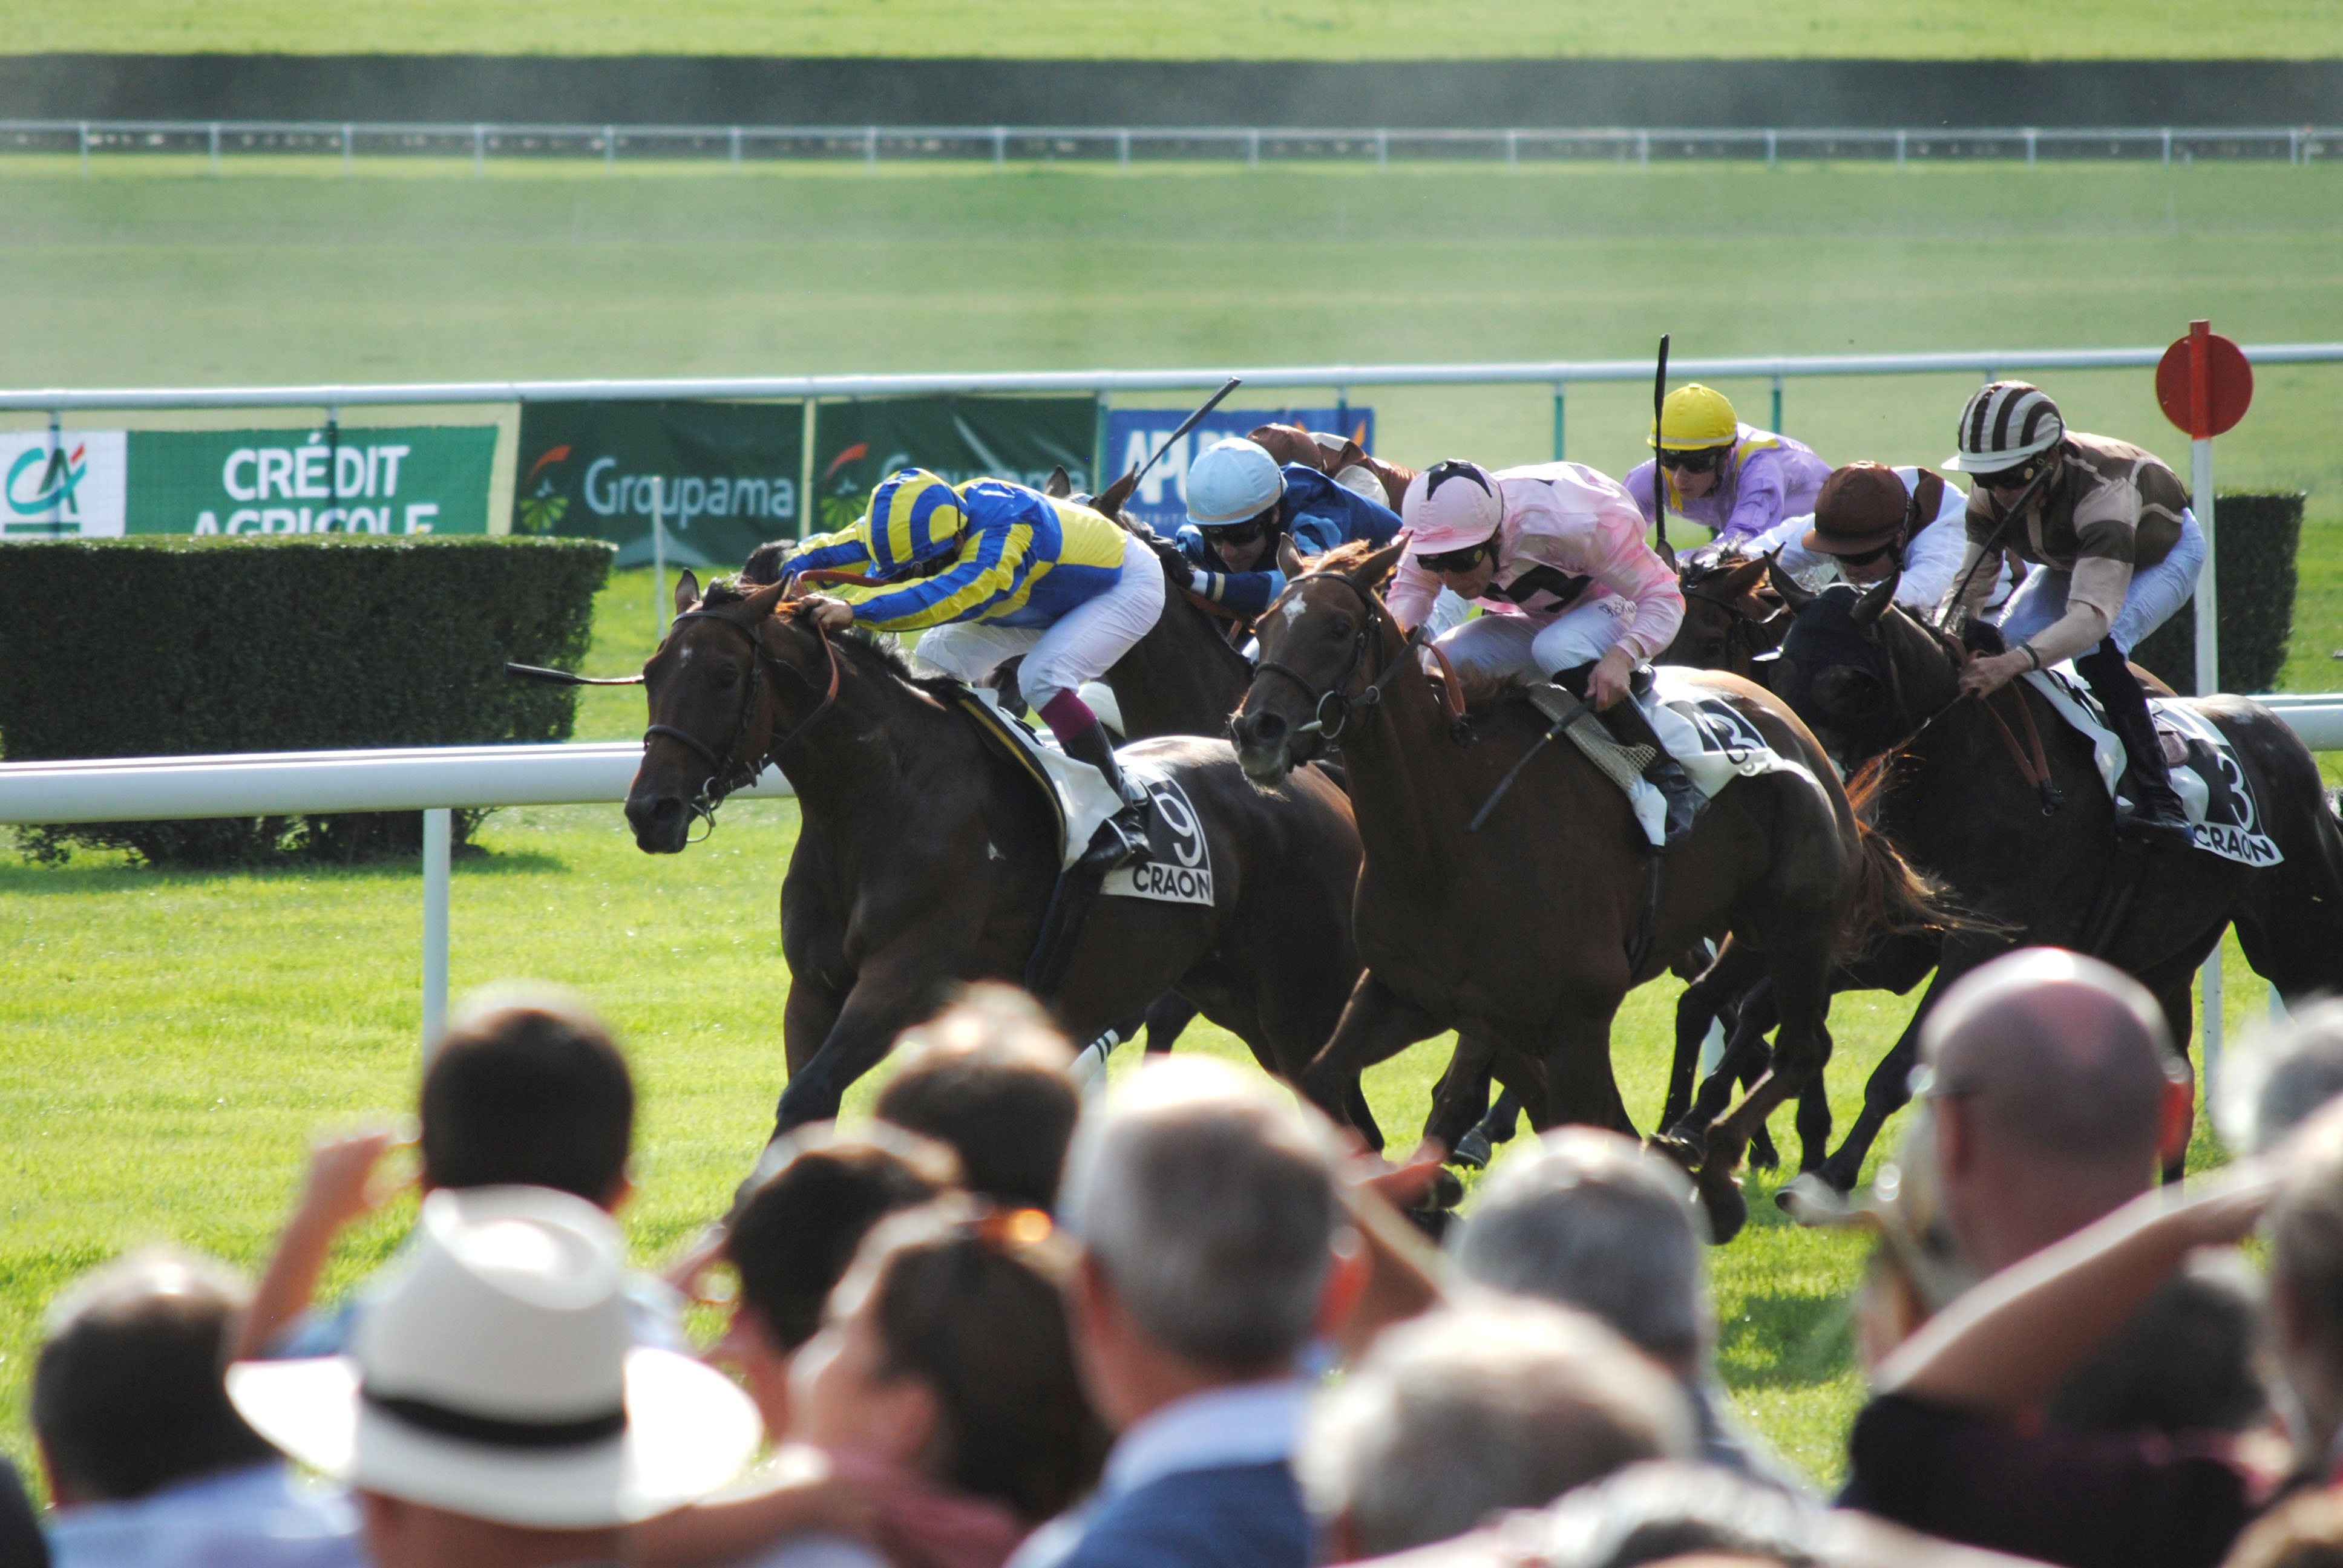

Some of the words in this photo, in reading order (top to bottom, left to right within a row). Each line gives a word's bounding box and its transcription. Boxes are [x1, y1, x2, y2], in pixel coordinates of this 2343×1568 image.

[222, 432, 411, 501] CRÉDIT
[584, 456, 795, 529] Groupama
[2216, 752, 2255, 832] 3
[1154, 792, 1202, 867] 9
[2194, 825, 2276, 863] CRAON
[1133, 863, 1210, 900] CRAON
